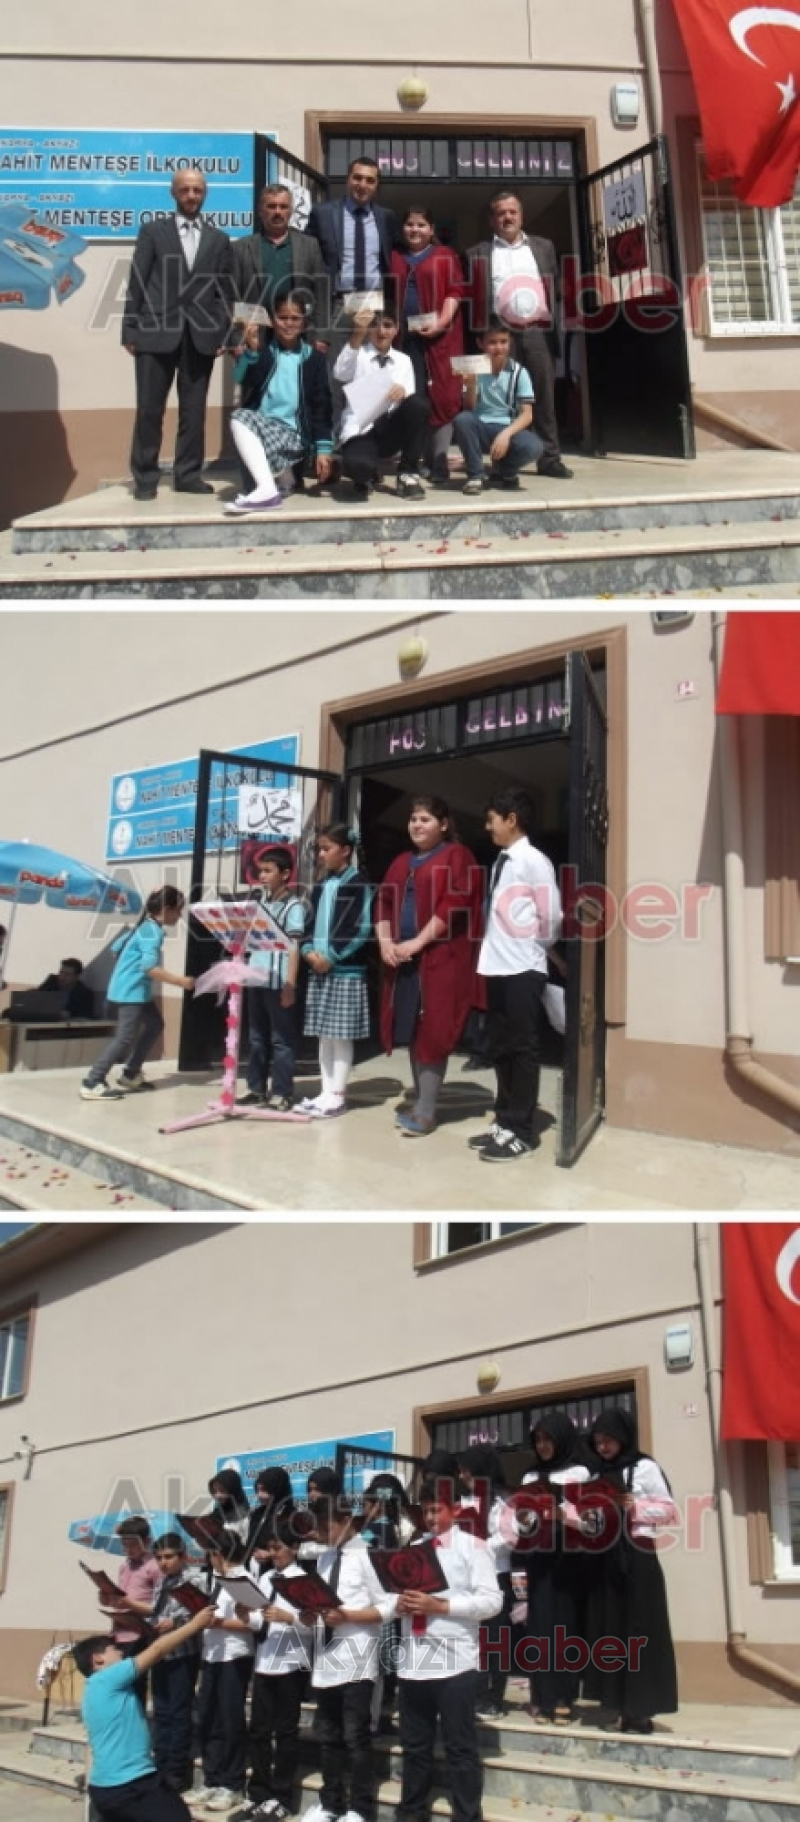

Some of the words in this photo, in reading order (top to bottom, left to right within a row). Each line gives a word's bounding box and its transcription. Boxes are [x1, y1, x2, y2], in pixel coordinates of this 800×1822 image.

[50, 153, 140, 176] MENTEŞE
[146, 151, 241, 174] İLKOKULU
[46, 209, 134, 230] MENTEŞE
